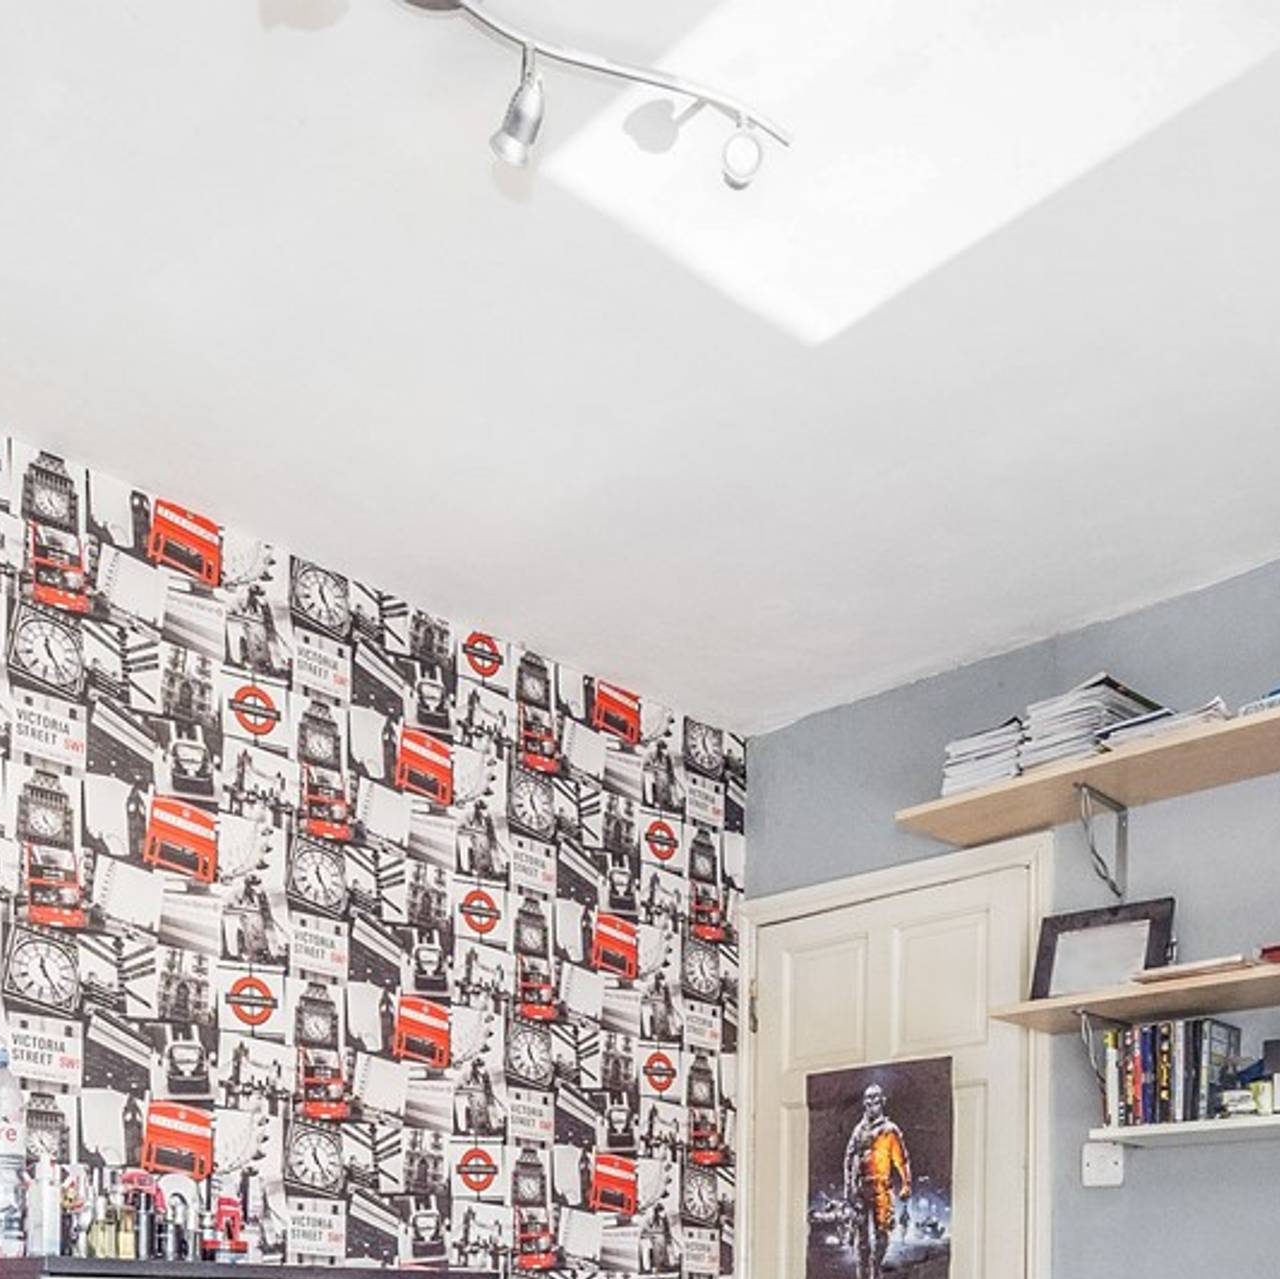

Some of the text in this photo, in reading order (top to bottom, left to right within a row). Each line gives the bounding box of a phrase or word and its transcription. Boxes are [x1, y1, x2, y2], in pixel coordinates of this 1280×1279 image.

[16, 707, 70, 734] VICTORIA
[16, 723, 57, 746] STREET
[11, 1033, 65, 1052] VICTORIA
[11, 1049, 53, 1065] STREET
